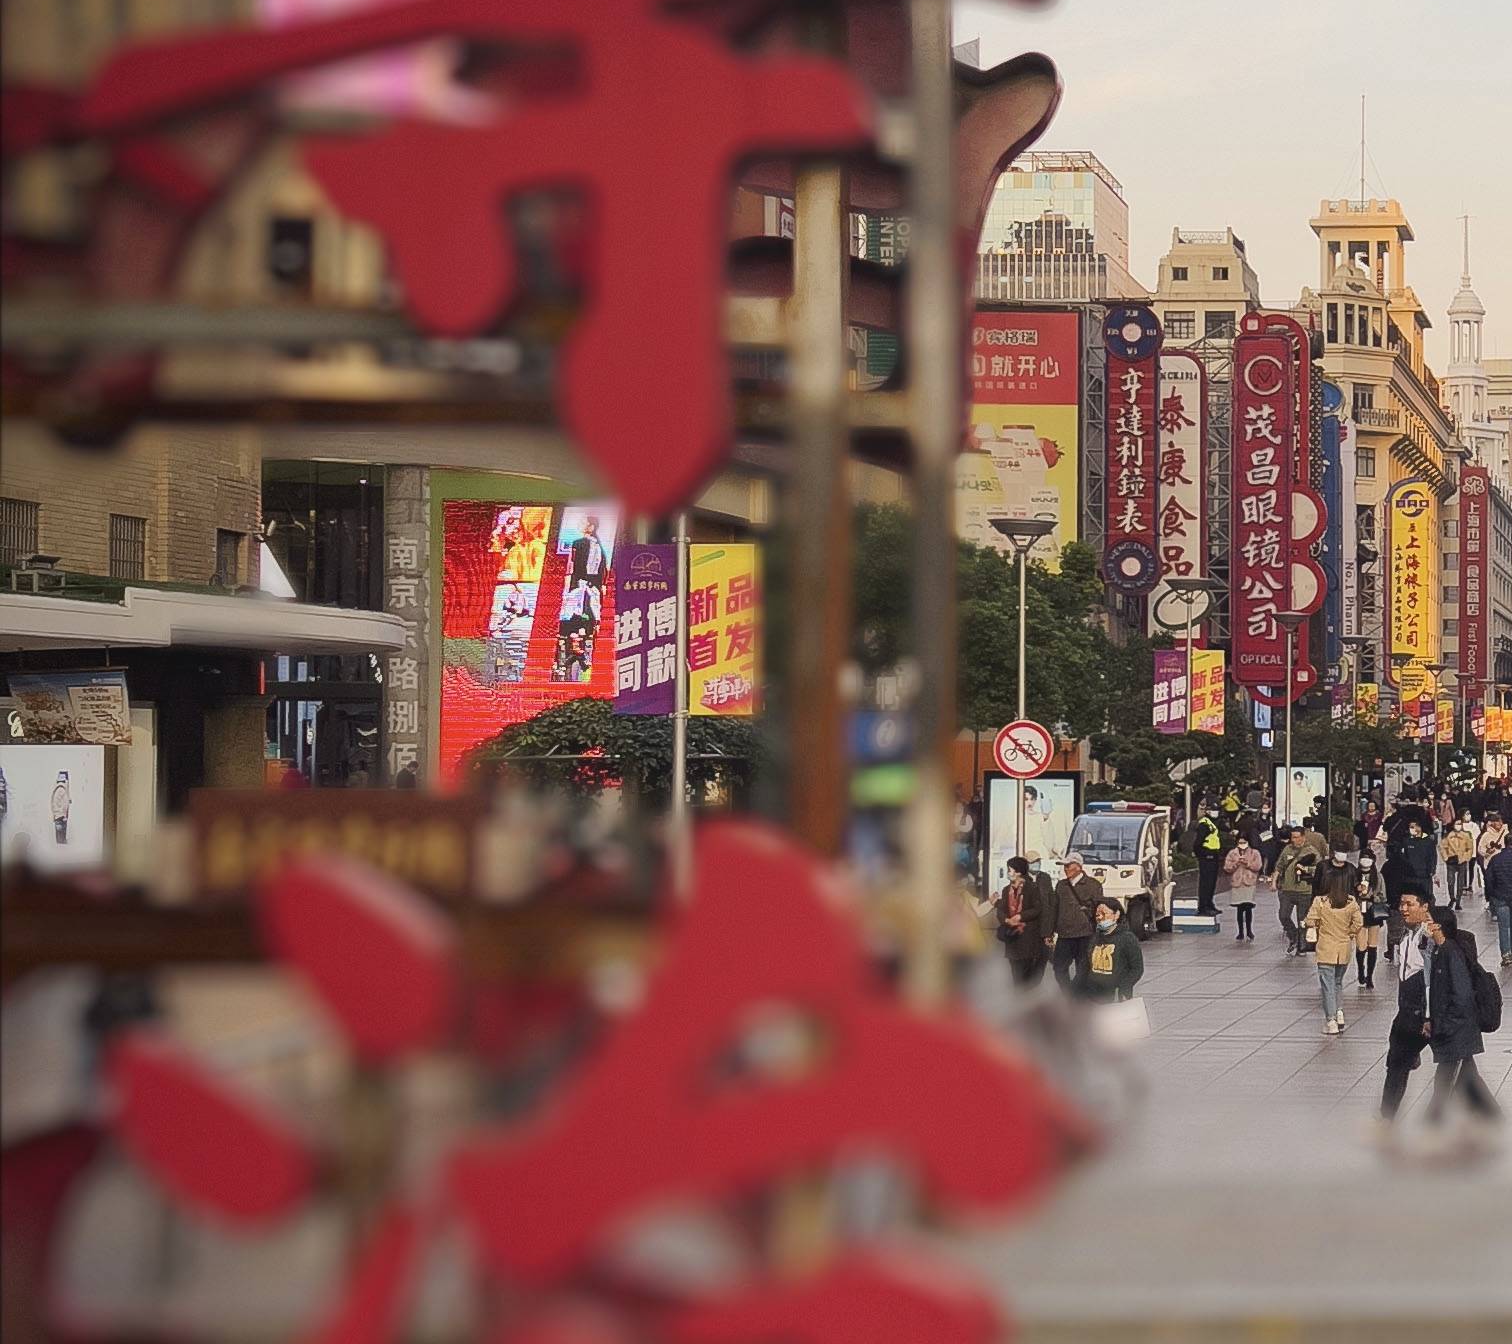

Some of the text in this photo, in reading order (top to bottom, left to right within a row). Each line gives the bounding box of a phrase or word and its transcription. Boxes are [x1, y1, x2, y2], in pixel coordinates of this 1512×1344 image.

[1159, 385, 1197, 577] 泰康食品
[1241, 403, 1285, 641] 茂昌眼镜公司
[616, 596, 677, 652] 进博
[690, 572, 757, 627] 新品
[1344, 596, 1355, 656] Pharmy
[616, 643, 676, 697] 同款
[690, 621, 757, 673] 首发
[1240, 654, 1284, 666] OPTICAL
